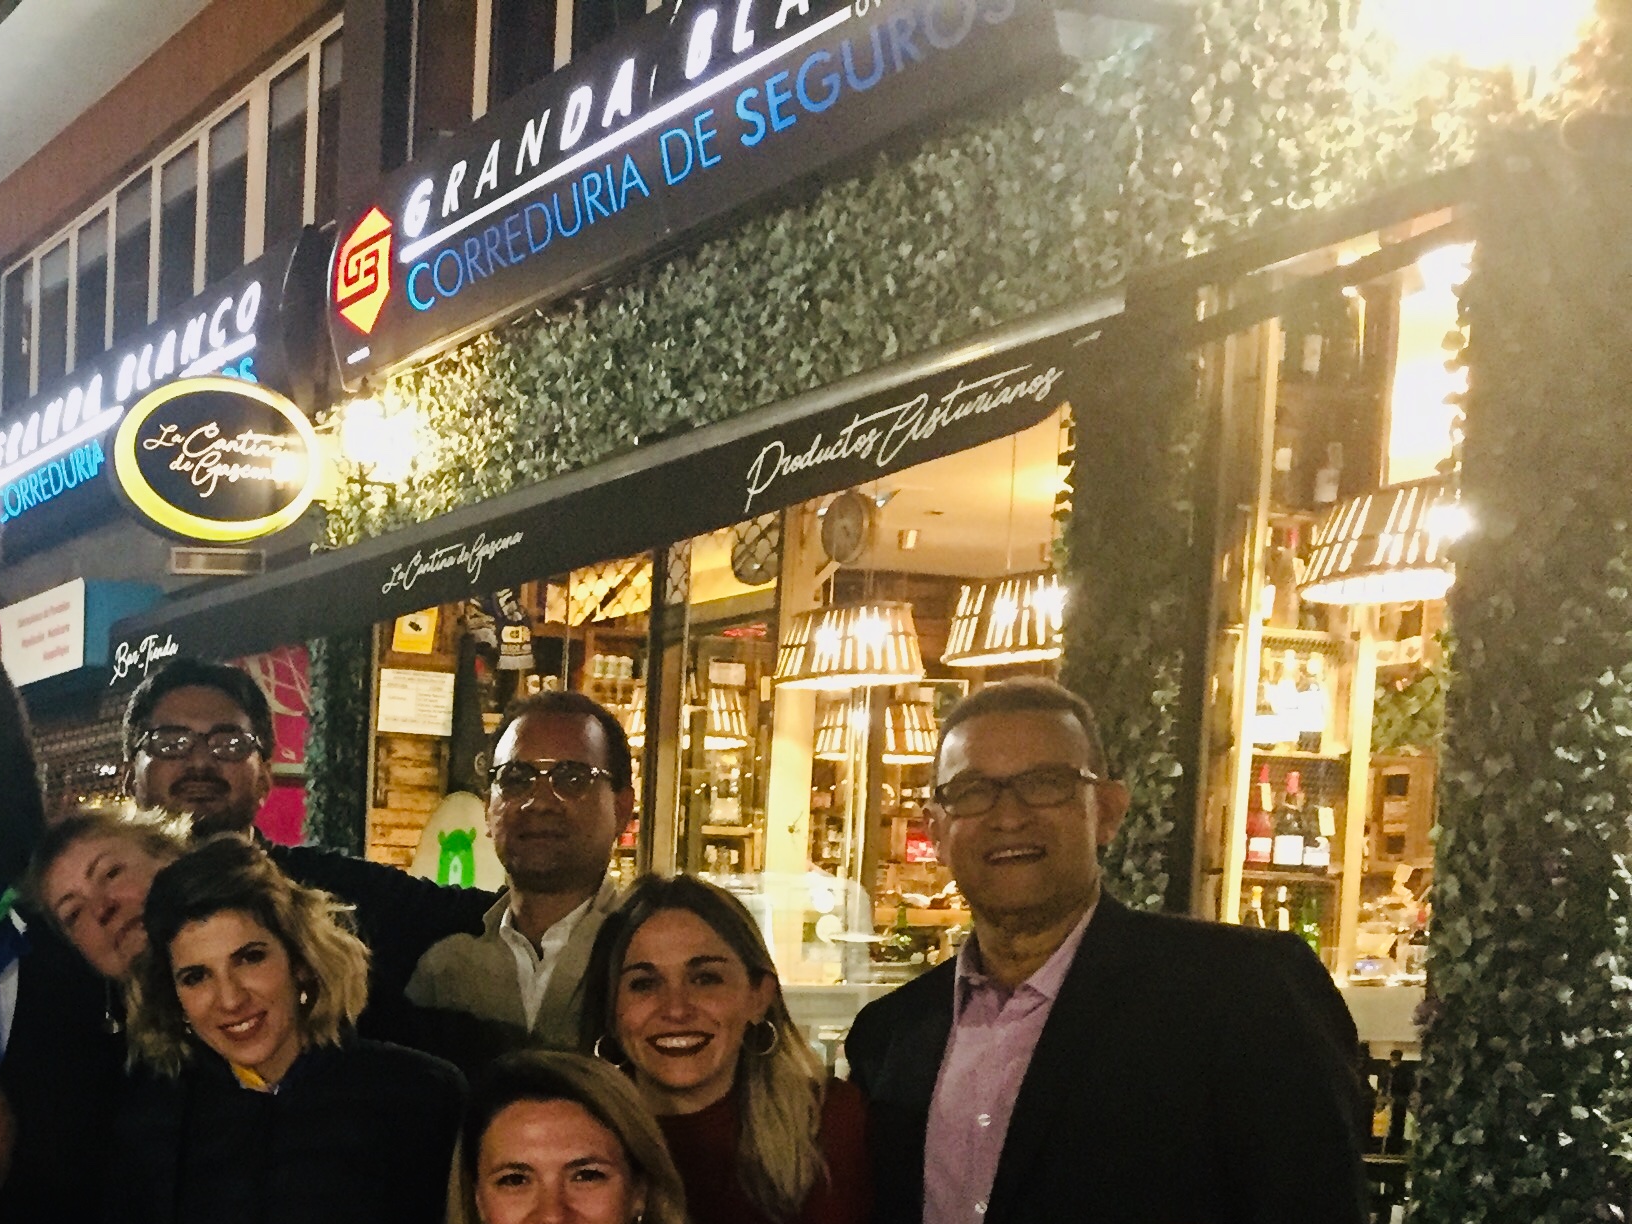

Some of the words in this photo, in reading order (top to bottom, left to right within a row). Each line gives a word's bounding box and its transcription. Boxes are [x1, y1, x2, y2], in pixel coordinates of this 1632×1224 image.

[401, 58, 635, 238] GRANDA
[406, 153, 651, 311] CORREDURIA
[659, 108, 722, 187] DE
[116, 280, 262, 401] BLANCO
[142, 423, 185, 450] La
[169, 453, 194, 471] de
[191, 451, 280, 498] Gascon
[744, 413, 884, 513] Productos
[877, 363, 1065, 467] Asturianos
[381, 562, 407, 594] La
